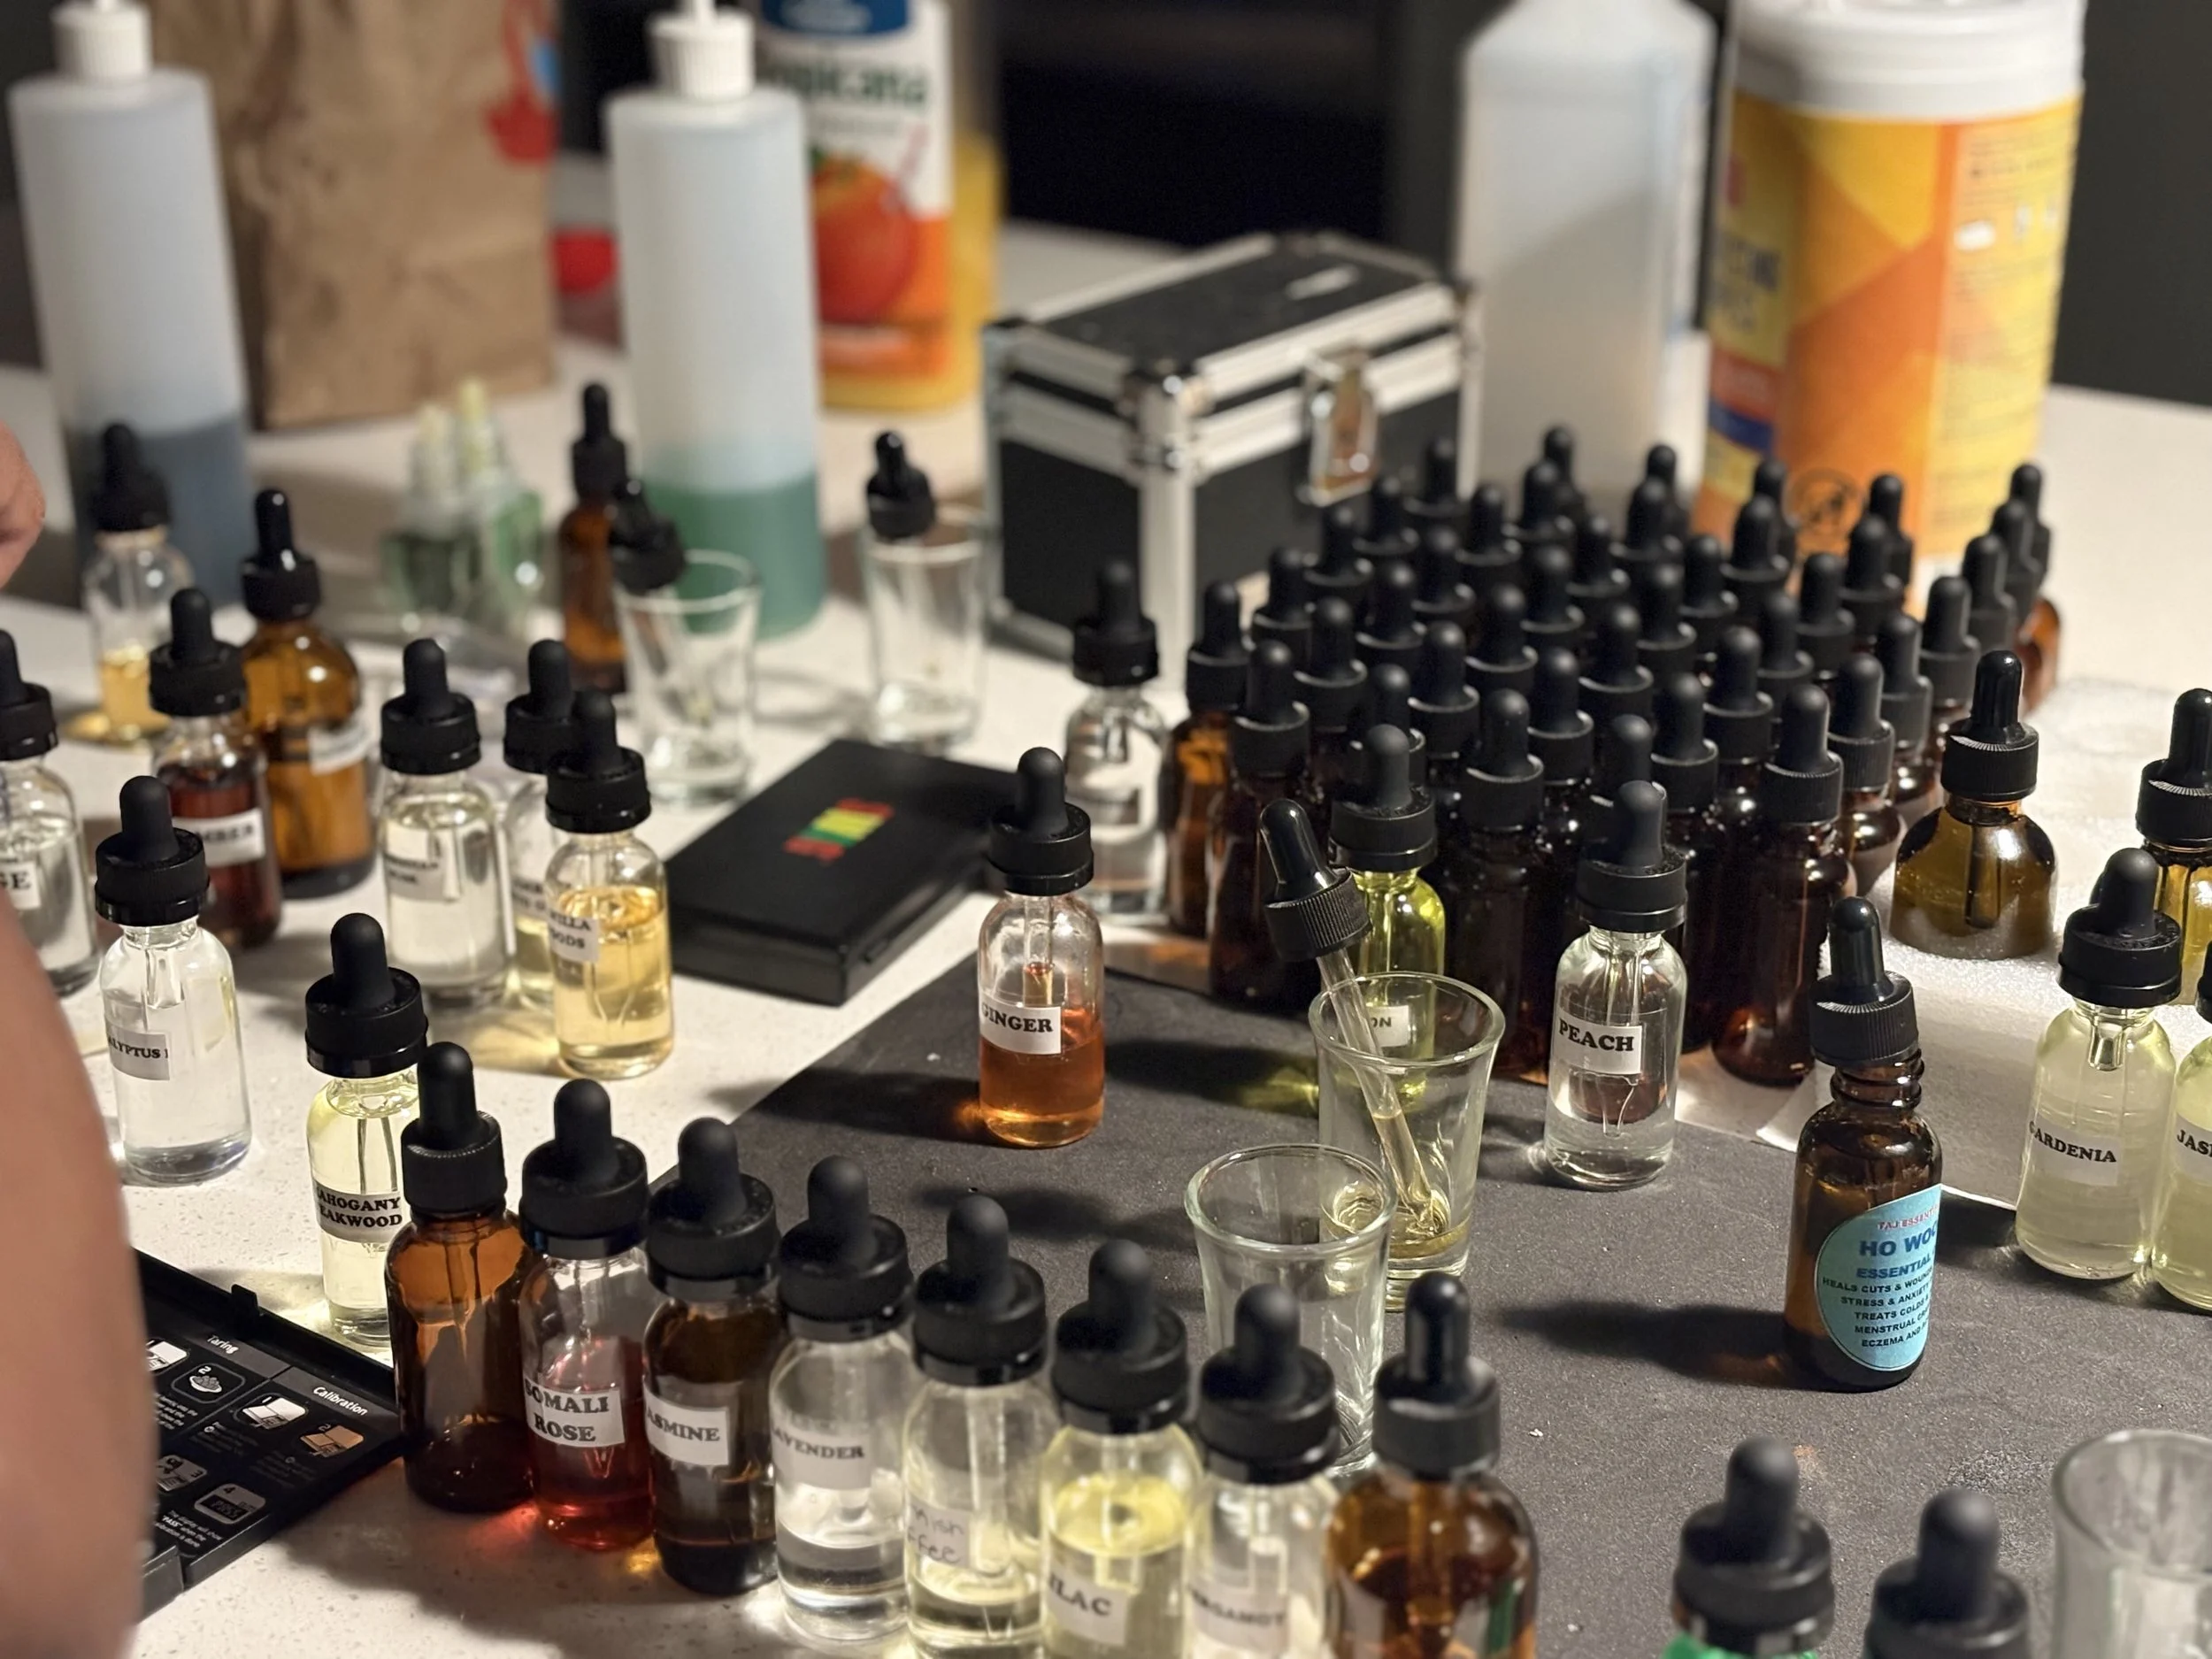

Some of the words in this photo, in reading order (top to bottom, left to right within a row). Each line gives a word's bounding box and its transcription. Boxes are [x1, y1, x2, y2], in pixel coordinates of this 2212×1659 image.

[982, 1002, 1053, 1033] GINGER
[1559, 1018, 1634, 1051] PEACH
[2029, 1121, 2117, 1163] GARDENIA
[319, 1204, 403, 1228] EAKWOOD
[1859, 1240, 1897, 1257] HO
[1856, 1253, 1932, 1279] ESSENTIAL
[1823, 1277, 1857, 1292] HEALS
[1840, 1296, 1885, 1307] STRESS
[1855, 1310, 1897, 1320] TREATS
[1900, 1300, 1925, 1317] COLDS
[1855, 1318, 1916, 1334] MENSTRUAL
[1862, 1335, 1904, 1347] ECZEMA
[1906, 1325, 1924, 1340] AND
[207, 1334, 239, 1355] Taring
[198, 1365, 211, 1375] 2
[312, 1386, 368, 1416] Calibration
[524, 1379, 611, 1414] SOMALI
[534, 1413, 596, 1443] ROSE
[772, 1425, 866, 1460] AVENDER
